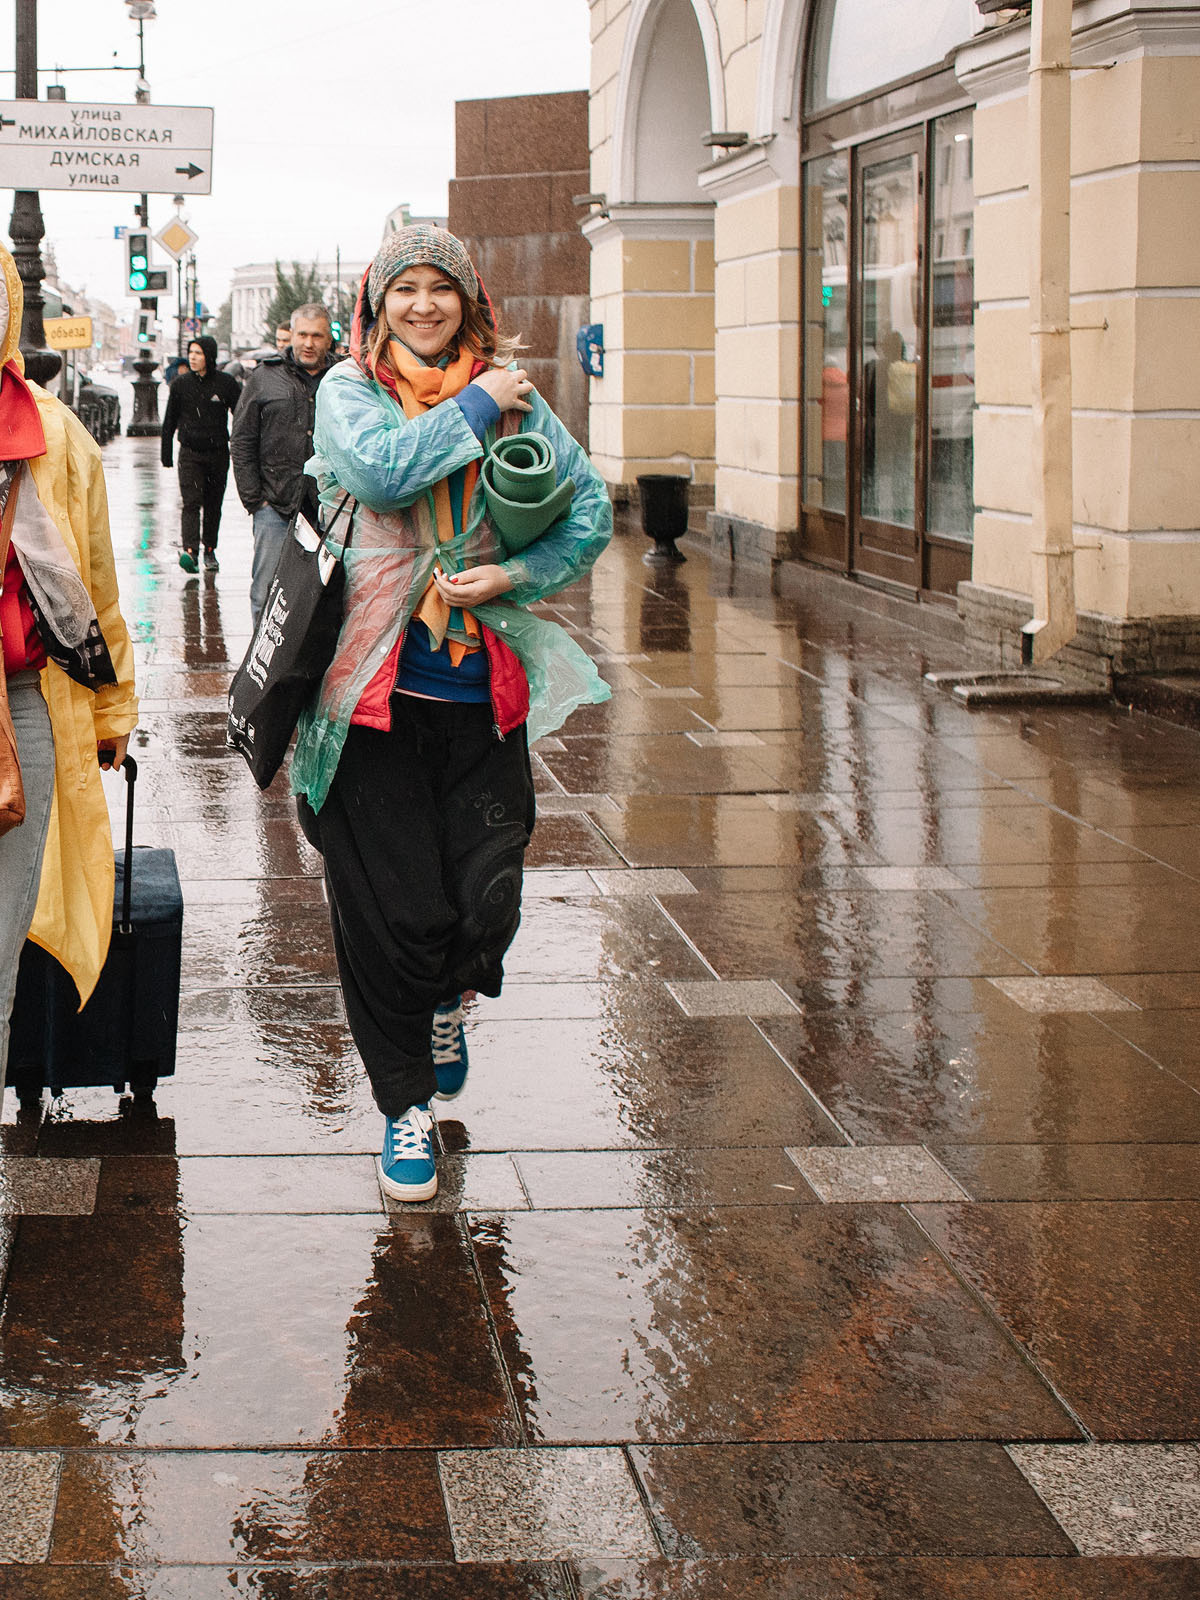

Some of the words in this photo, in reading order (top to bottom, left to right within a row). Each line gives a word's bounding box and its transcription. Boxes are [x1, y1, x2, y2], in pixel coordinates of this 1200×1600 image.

[71, 109, 122, 122] улица
[20, 123, 172, 143] МИХАЙЛОВСКАЯ
[50, 151, 140, 167] ДУМСКАЯ
[69, 173, 120, 186] улица
